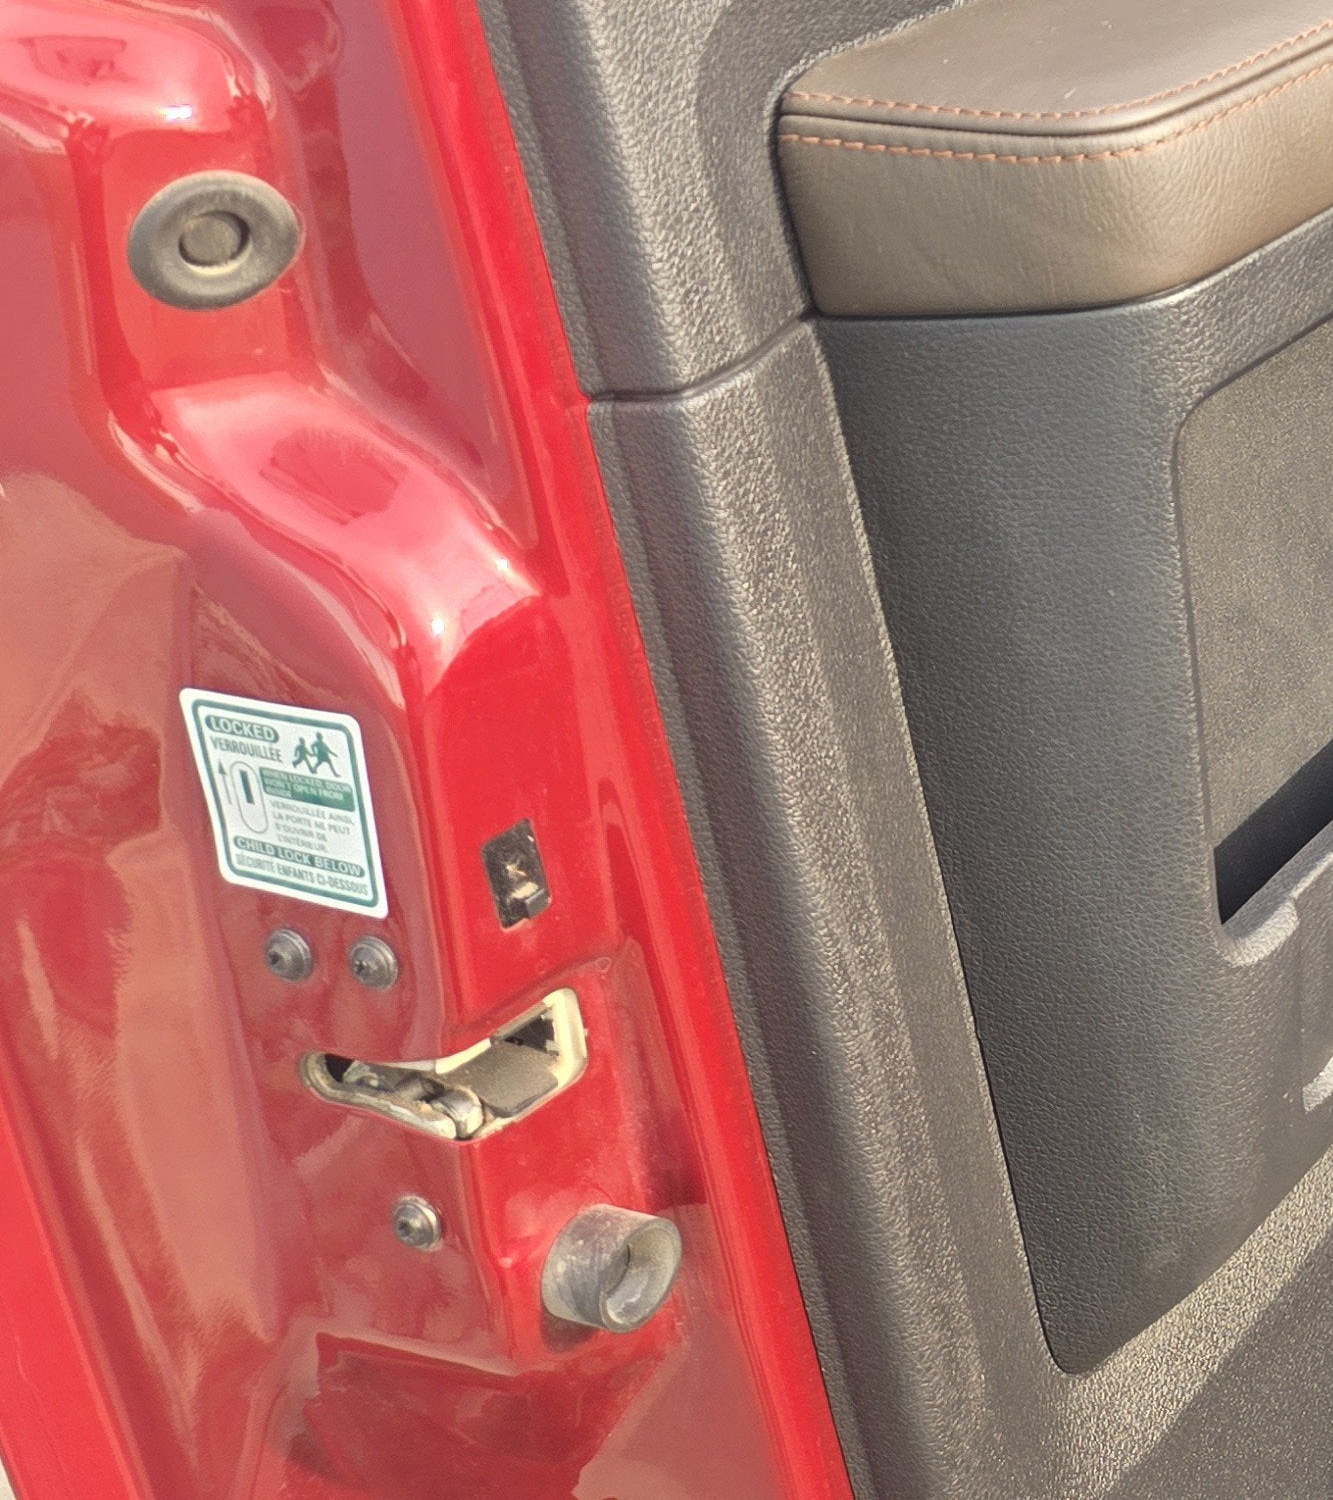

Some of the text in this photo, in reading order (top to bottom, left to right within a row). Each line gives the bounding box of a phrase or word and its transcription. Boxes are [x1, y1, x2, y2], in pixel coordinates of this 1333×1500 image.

[209, 716, 276, 741] LOCKED
[237, 837, 362, 876] CHILD LOCK BELOW
[276, 862, 314, 880] ENFANTS
